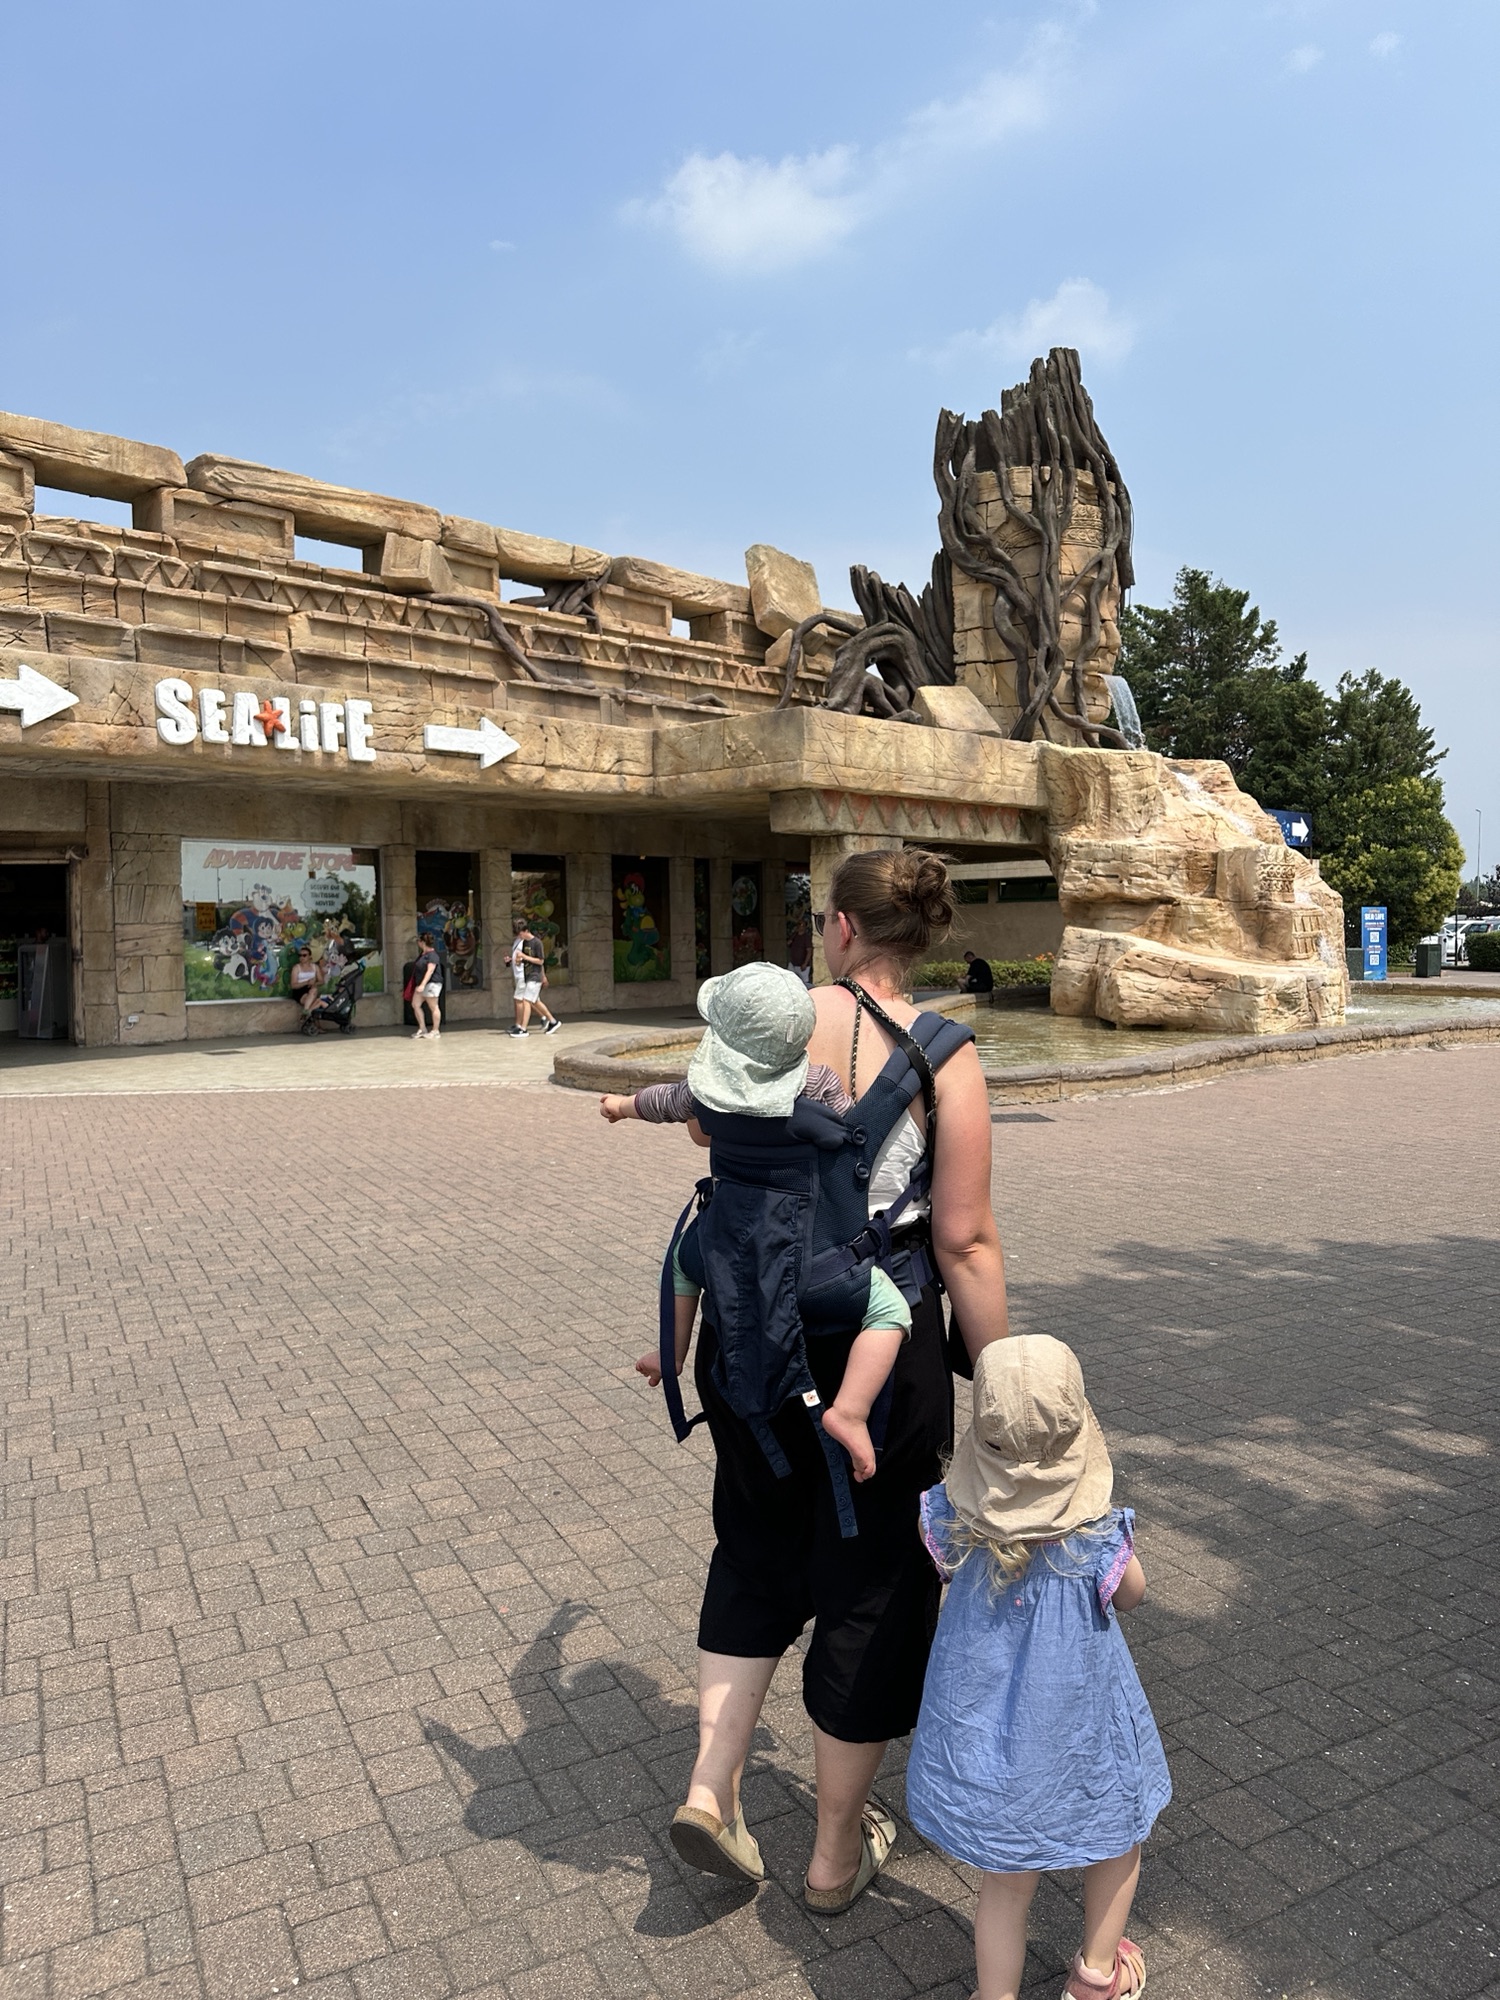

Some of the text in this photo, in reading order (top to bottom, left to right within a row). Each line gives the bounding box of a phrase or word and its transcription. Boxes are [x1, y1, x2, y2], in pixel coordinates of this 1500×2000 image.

[155, 677, 267, 747] SEA
[203, 848, 360, 872] ADVENTURE STORE
